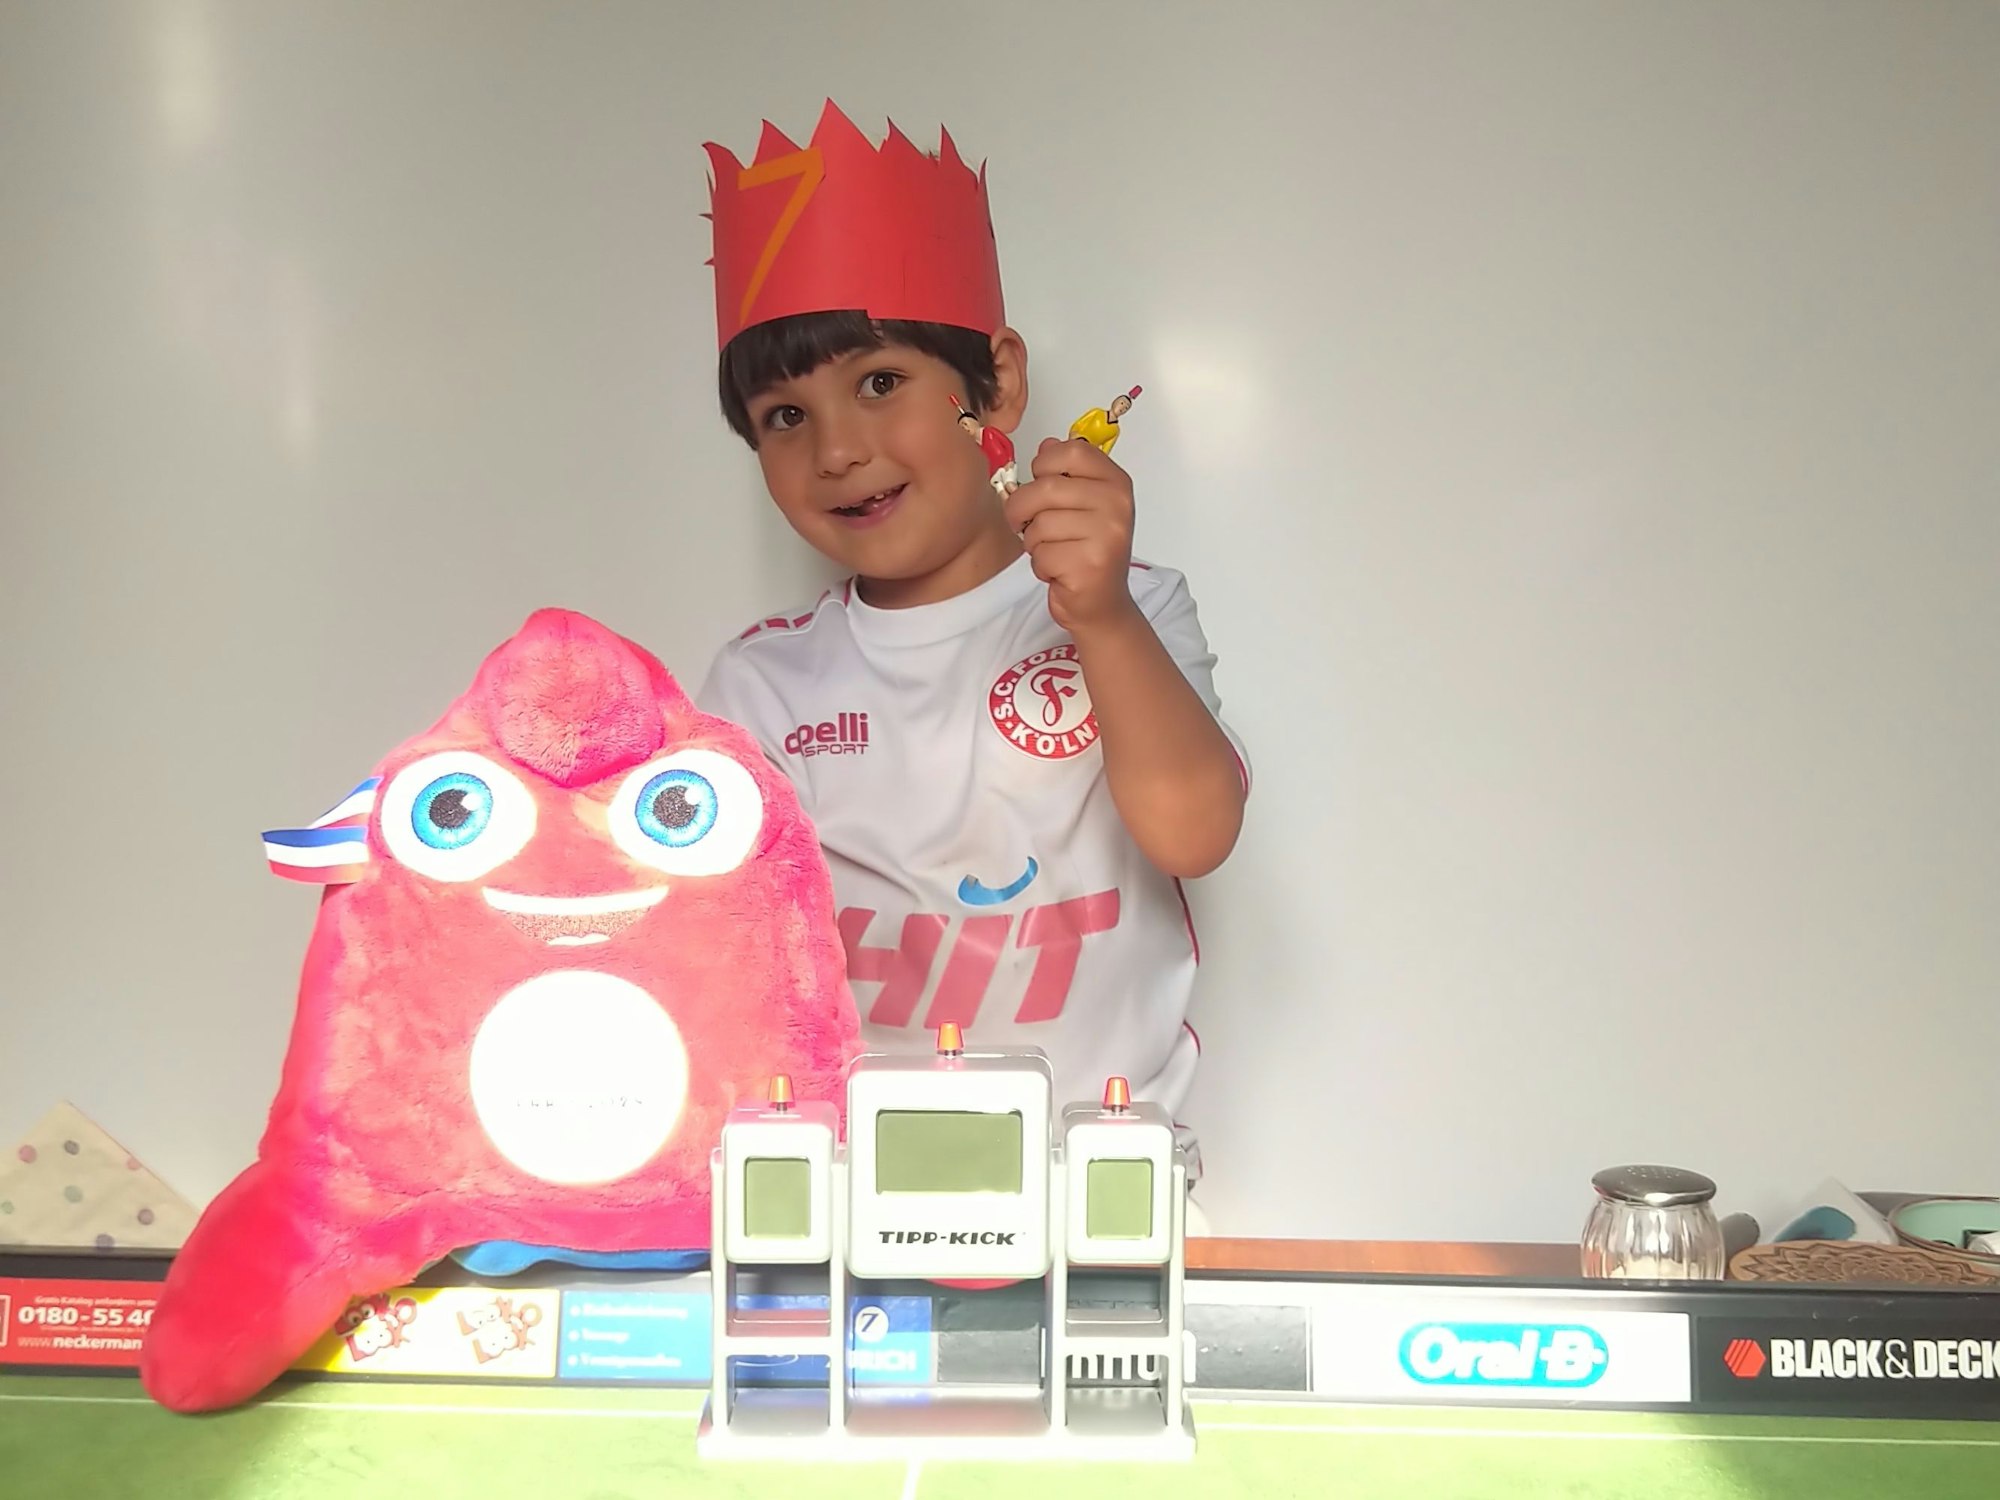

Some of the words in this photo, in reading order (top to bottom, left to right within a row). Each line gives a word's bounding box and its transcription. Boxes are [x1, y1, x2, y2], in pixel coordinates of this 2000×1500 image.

[738, 146, 825, 328] 7
[1012, 646, 1079, 675] FOR
[804, 743, 869, 757] SPORT
[838, 887, 1121, 1029] HIT
[879, 1231, 1016, 1245] TIPP-KICK
